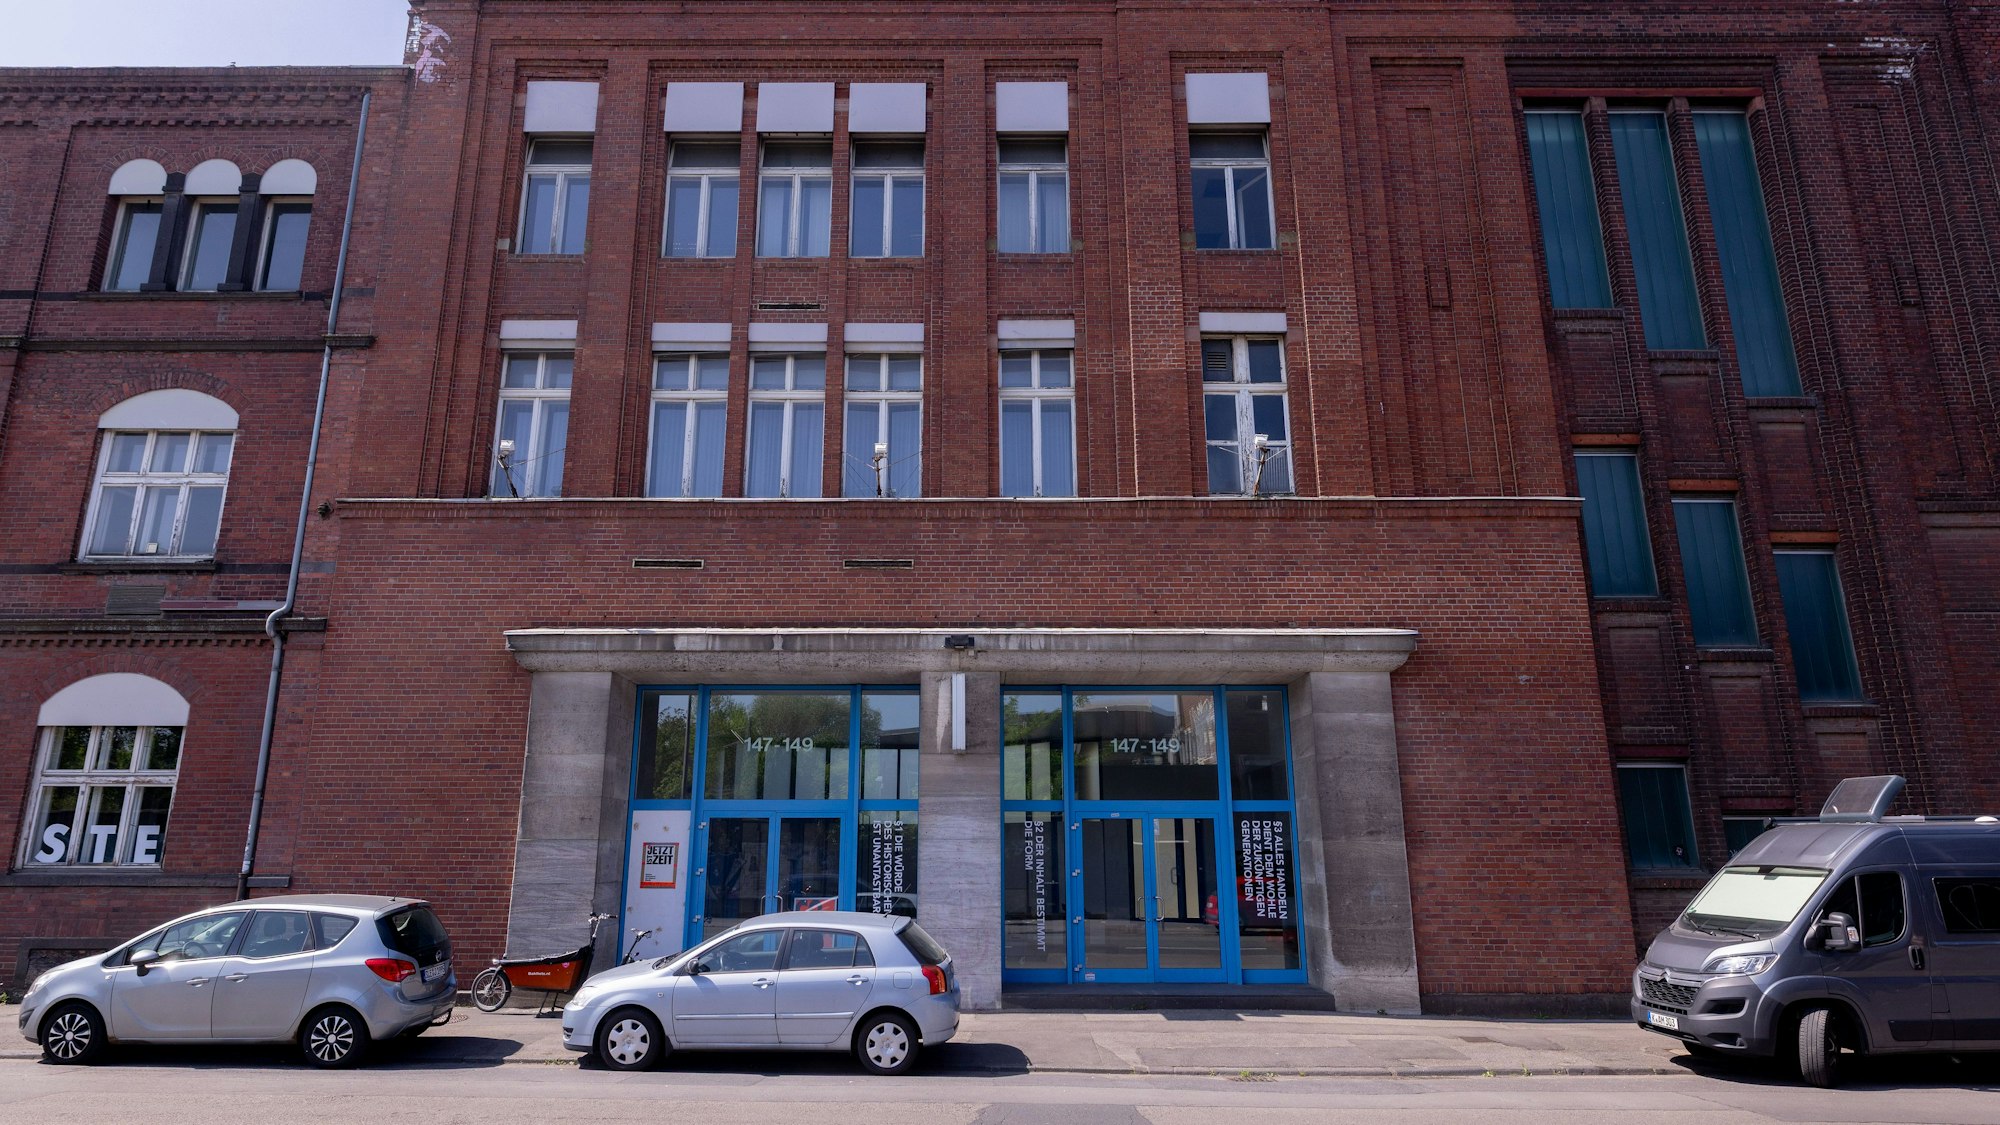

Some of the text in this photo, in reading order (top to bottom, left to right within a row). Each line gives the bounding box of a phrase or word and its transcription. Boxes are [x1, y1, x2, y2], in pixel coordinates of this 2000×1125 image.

[743, 737, 814, 752] 147-149
[1110, 738, 1180, 753] 147-149
[883, 820, 892, 840] DES
[894, 835, 903, 852] DIE
[1024, 820, 1033, 870] DIE FORM
[1035, 835, 1044, 856] DER
[647, 845, 674, 854] JETZT
[652, 855, 673, 864] ZEIT
[872, 820, 881, 913] IST UNANTASTBAR
[1241, 820, 1254, 902] GENERATIONEN
[1274, 835, 1285, 866] ALLES
[894, 854, 904, 892] WÜRDE
[1035, 859, 1045, 895] INHALT
[1251, 820, 1266, 917] DER ZUKÜNFTIGEN
[1262, 820, 1277, 919] DIENT DEM WOHLE
[1276, 868, 1287, 919] HANDELN
[1036, 897, 1046, 951] BESTIMMT
